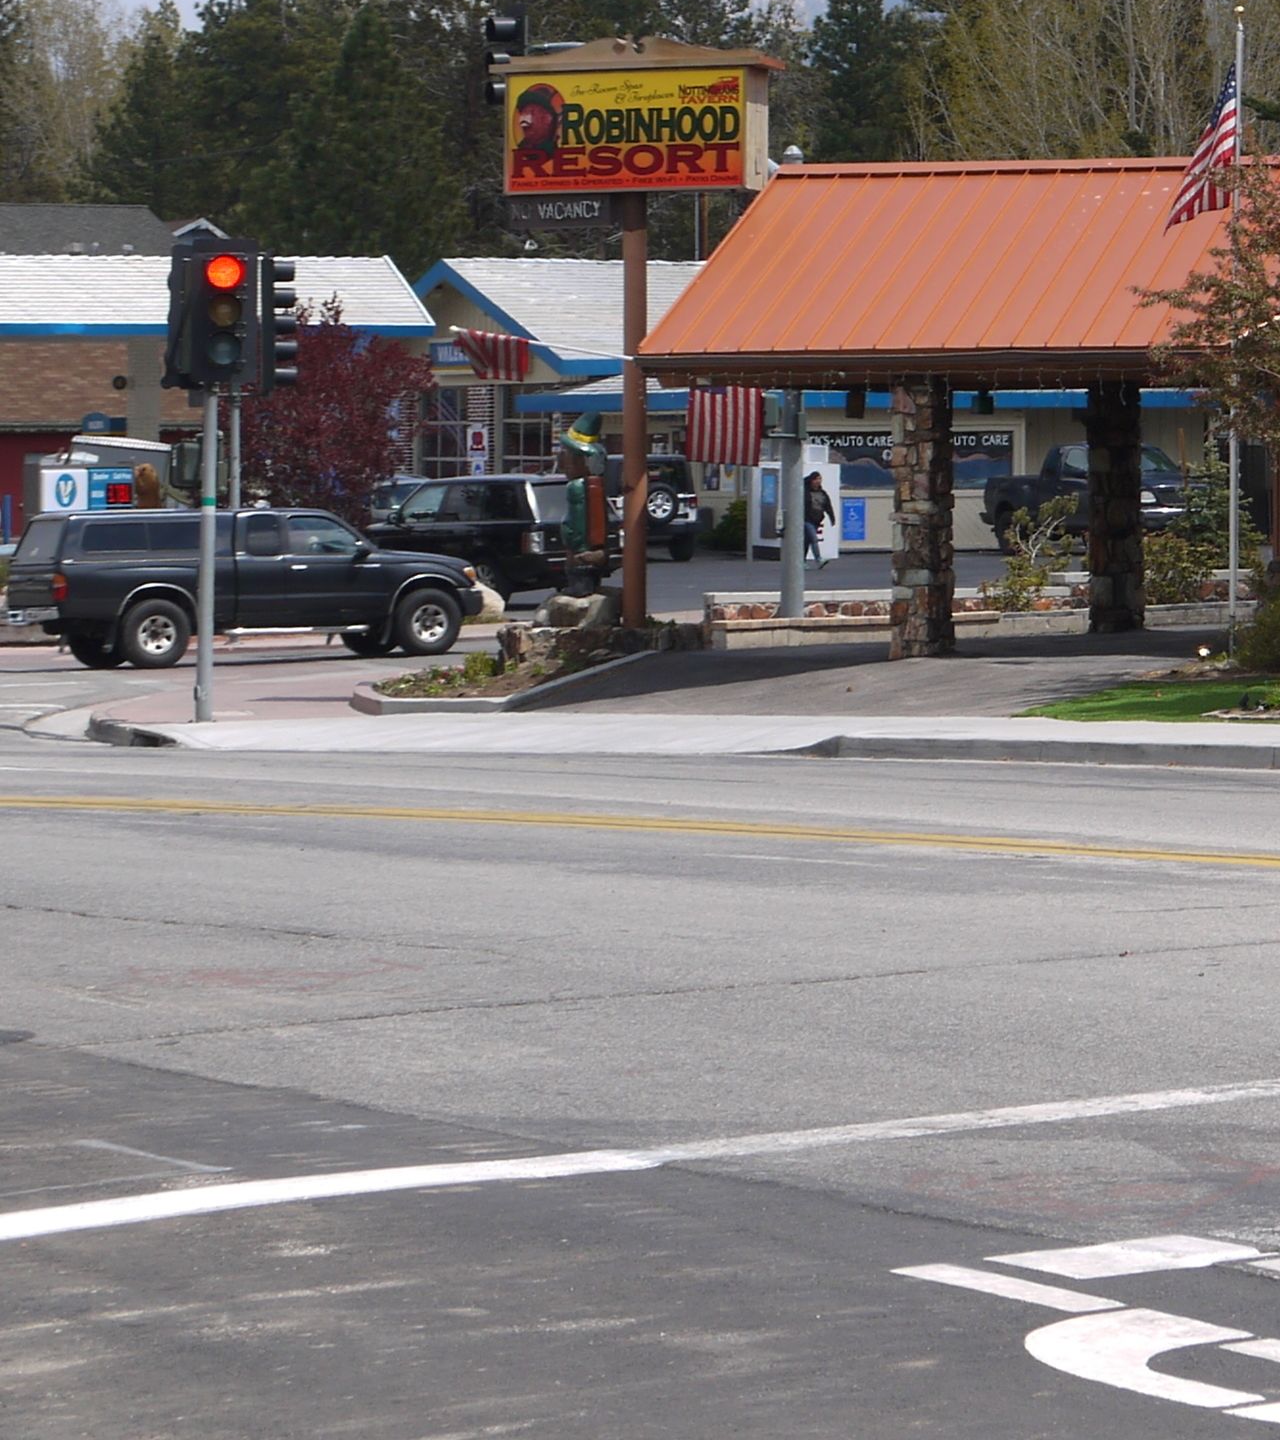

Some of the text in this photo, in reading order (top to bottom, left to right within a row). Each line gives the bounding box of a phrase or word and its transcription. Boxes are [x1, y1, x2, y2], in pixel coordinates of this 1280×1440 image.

[680, 94, 740, 104] TAVERN
[561, 103, 740, 146] ROBINHOOD
[511, 141, 740, 179] RESORT
[538, 200, 601, 220] VACANCY
[867, 435, 894, 447] CARE
[951, 434, 1009, 447] UTO CARE
